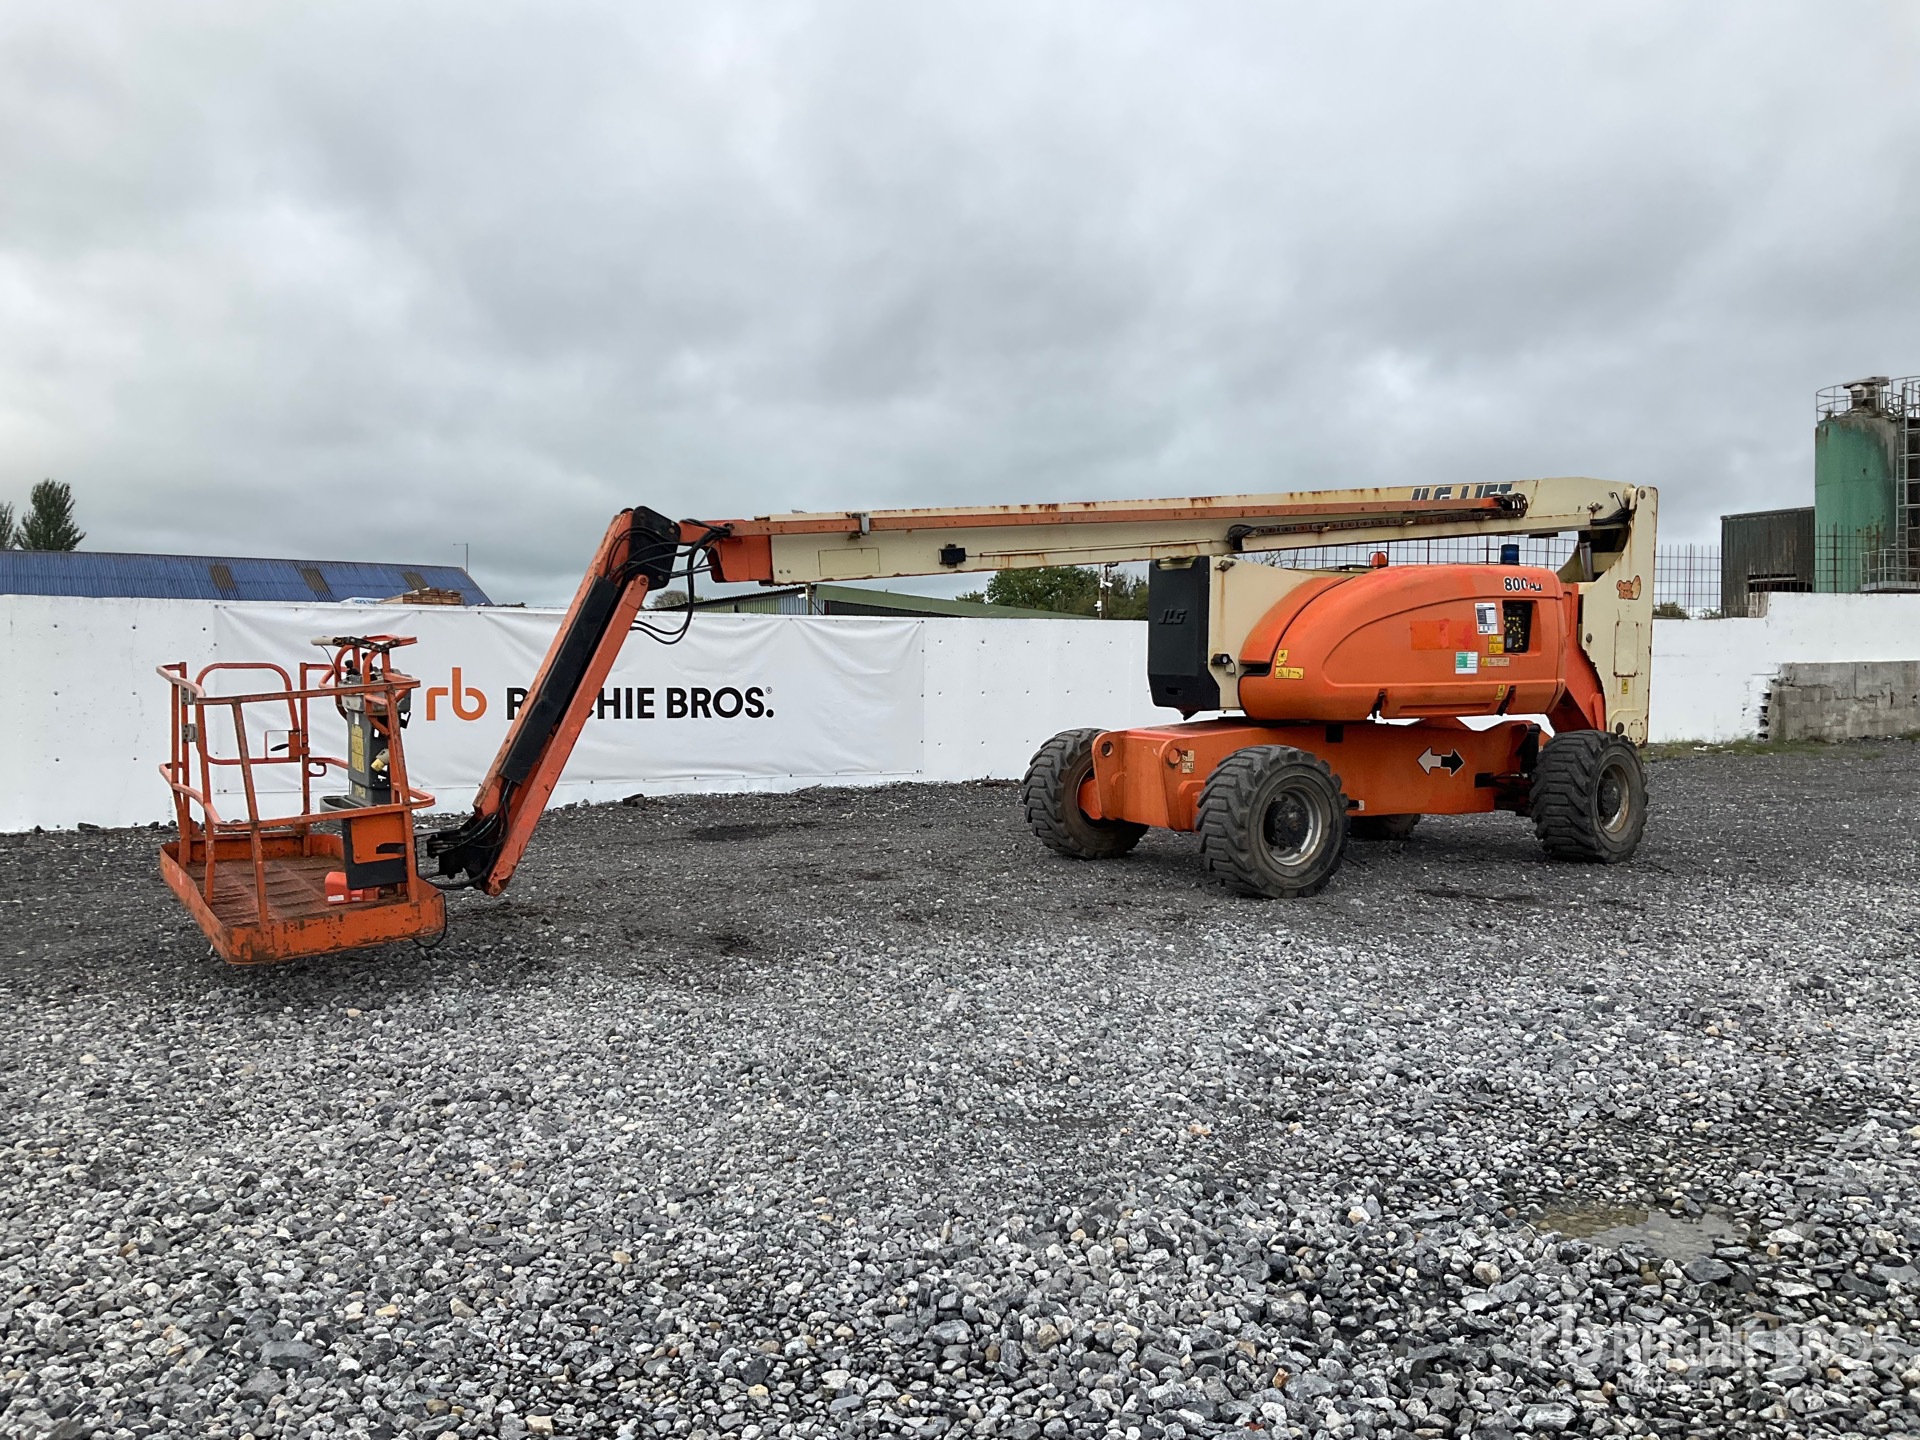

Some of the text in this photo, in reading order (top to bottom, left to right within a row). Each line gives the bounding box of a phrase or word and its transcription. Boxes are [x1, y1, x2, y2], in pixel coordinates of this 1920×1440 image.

[1158, 608, 1188, 625] JLG
[426, 667, 487, 721] rb
[506, 687, 655, 720] RHIE
